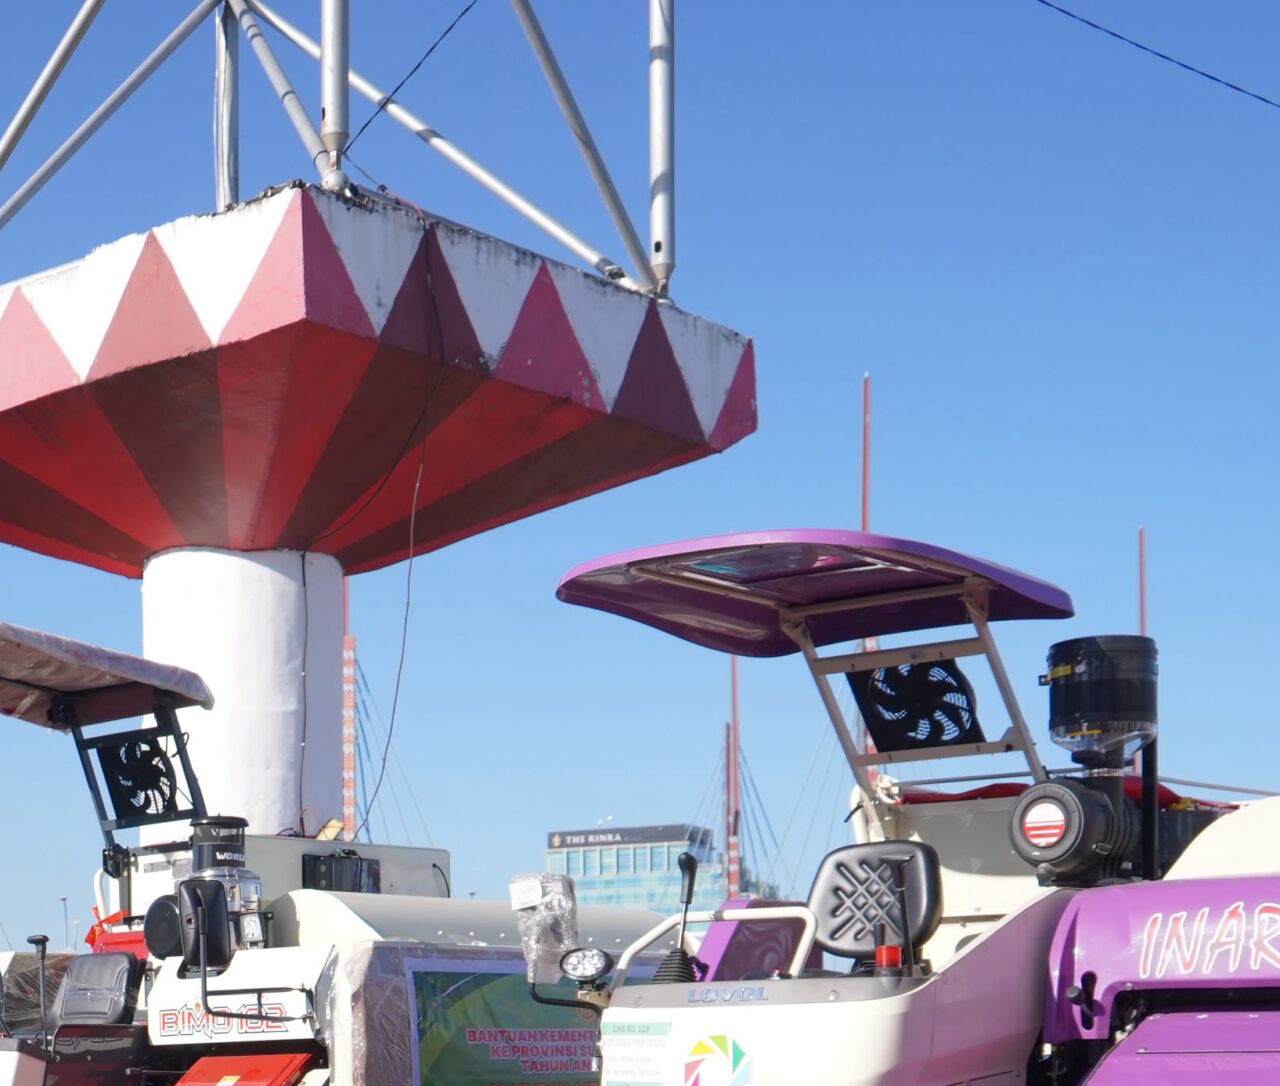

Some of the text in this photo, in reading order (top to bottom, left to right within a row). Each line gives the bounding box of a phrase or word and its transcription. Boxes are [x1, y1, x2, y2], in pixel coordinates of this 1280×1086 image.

[565, 835, 586, 844] THE
[587, 833, 622, 843] RINRA
[687, 987, 769, 1003] LOVOL
[466, 1029, 537, 1043] BANTUAN
[490, 1044, 510, 1058] KE
[511, 1044, 578, 1058] PROVINSI
[520, 1059, 569, 1072] TAHUN
